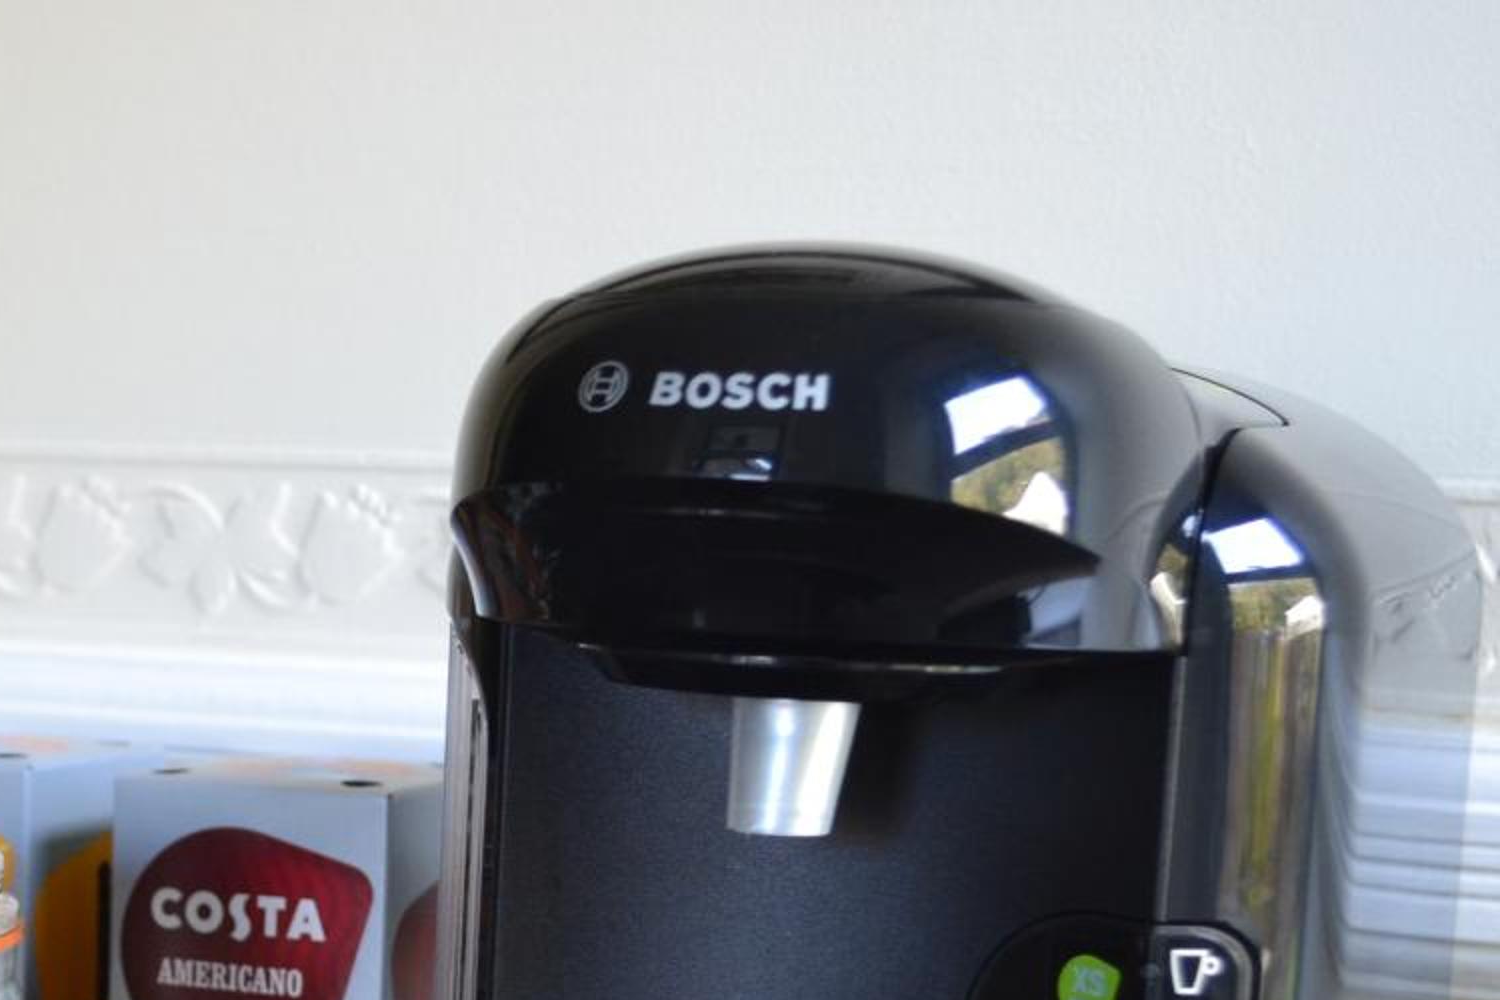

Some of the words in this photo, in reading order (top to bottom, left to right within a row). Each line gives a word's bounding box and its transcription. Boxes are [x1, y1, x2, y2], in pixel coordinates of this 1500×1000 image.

[649, 371, 831, 411] BOSCH
[151, 886, 327, 943] COSTA
[156, 957, 304, 999] AMERICANO
